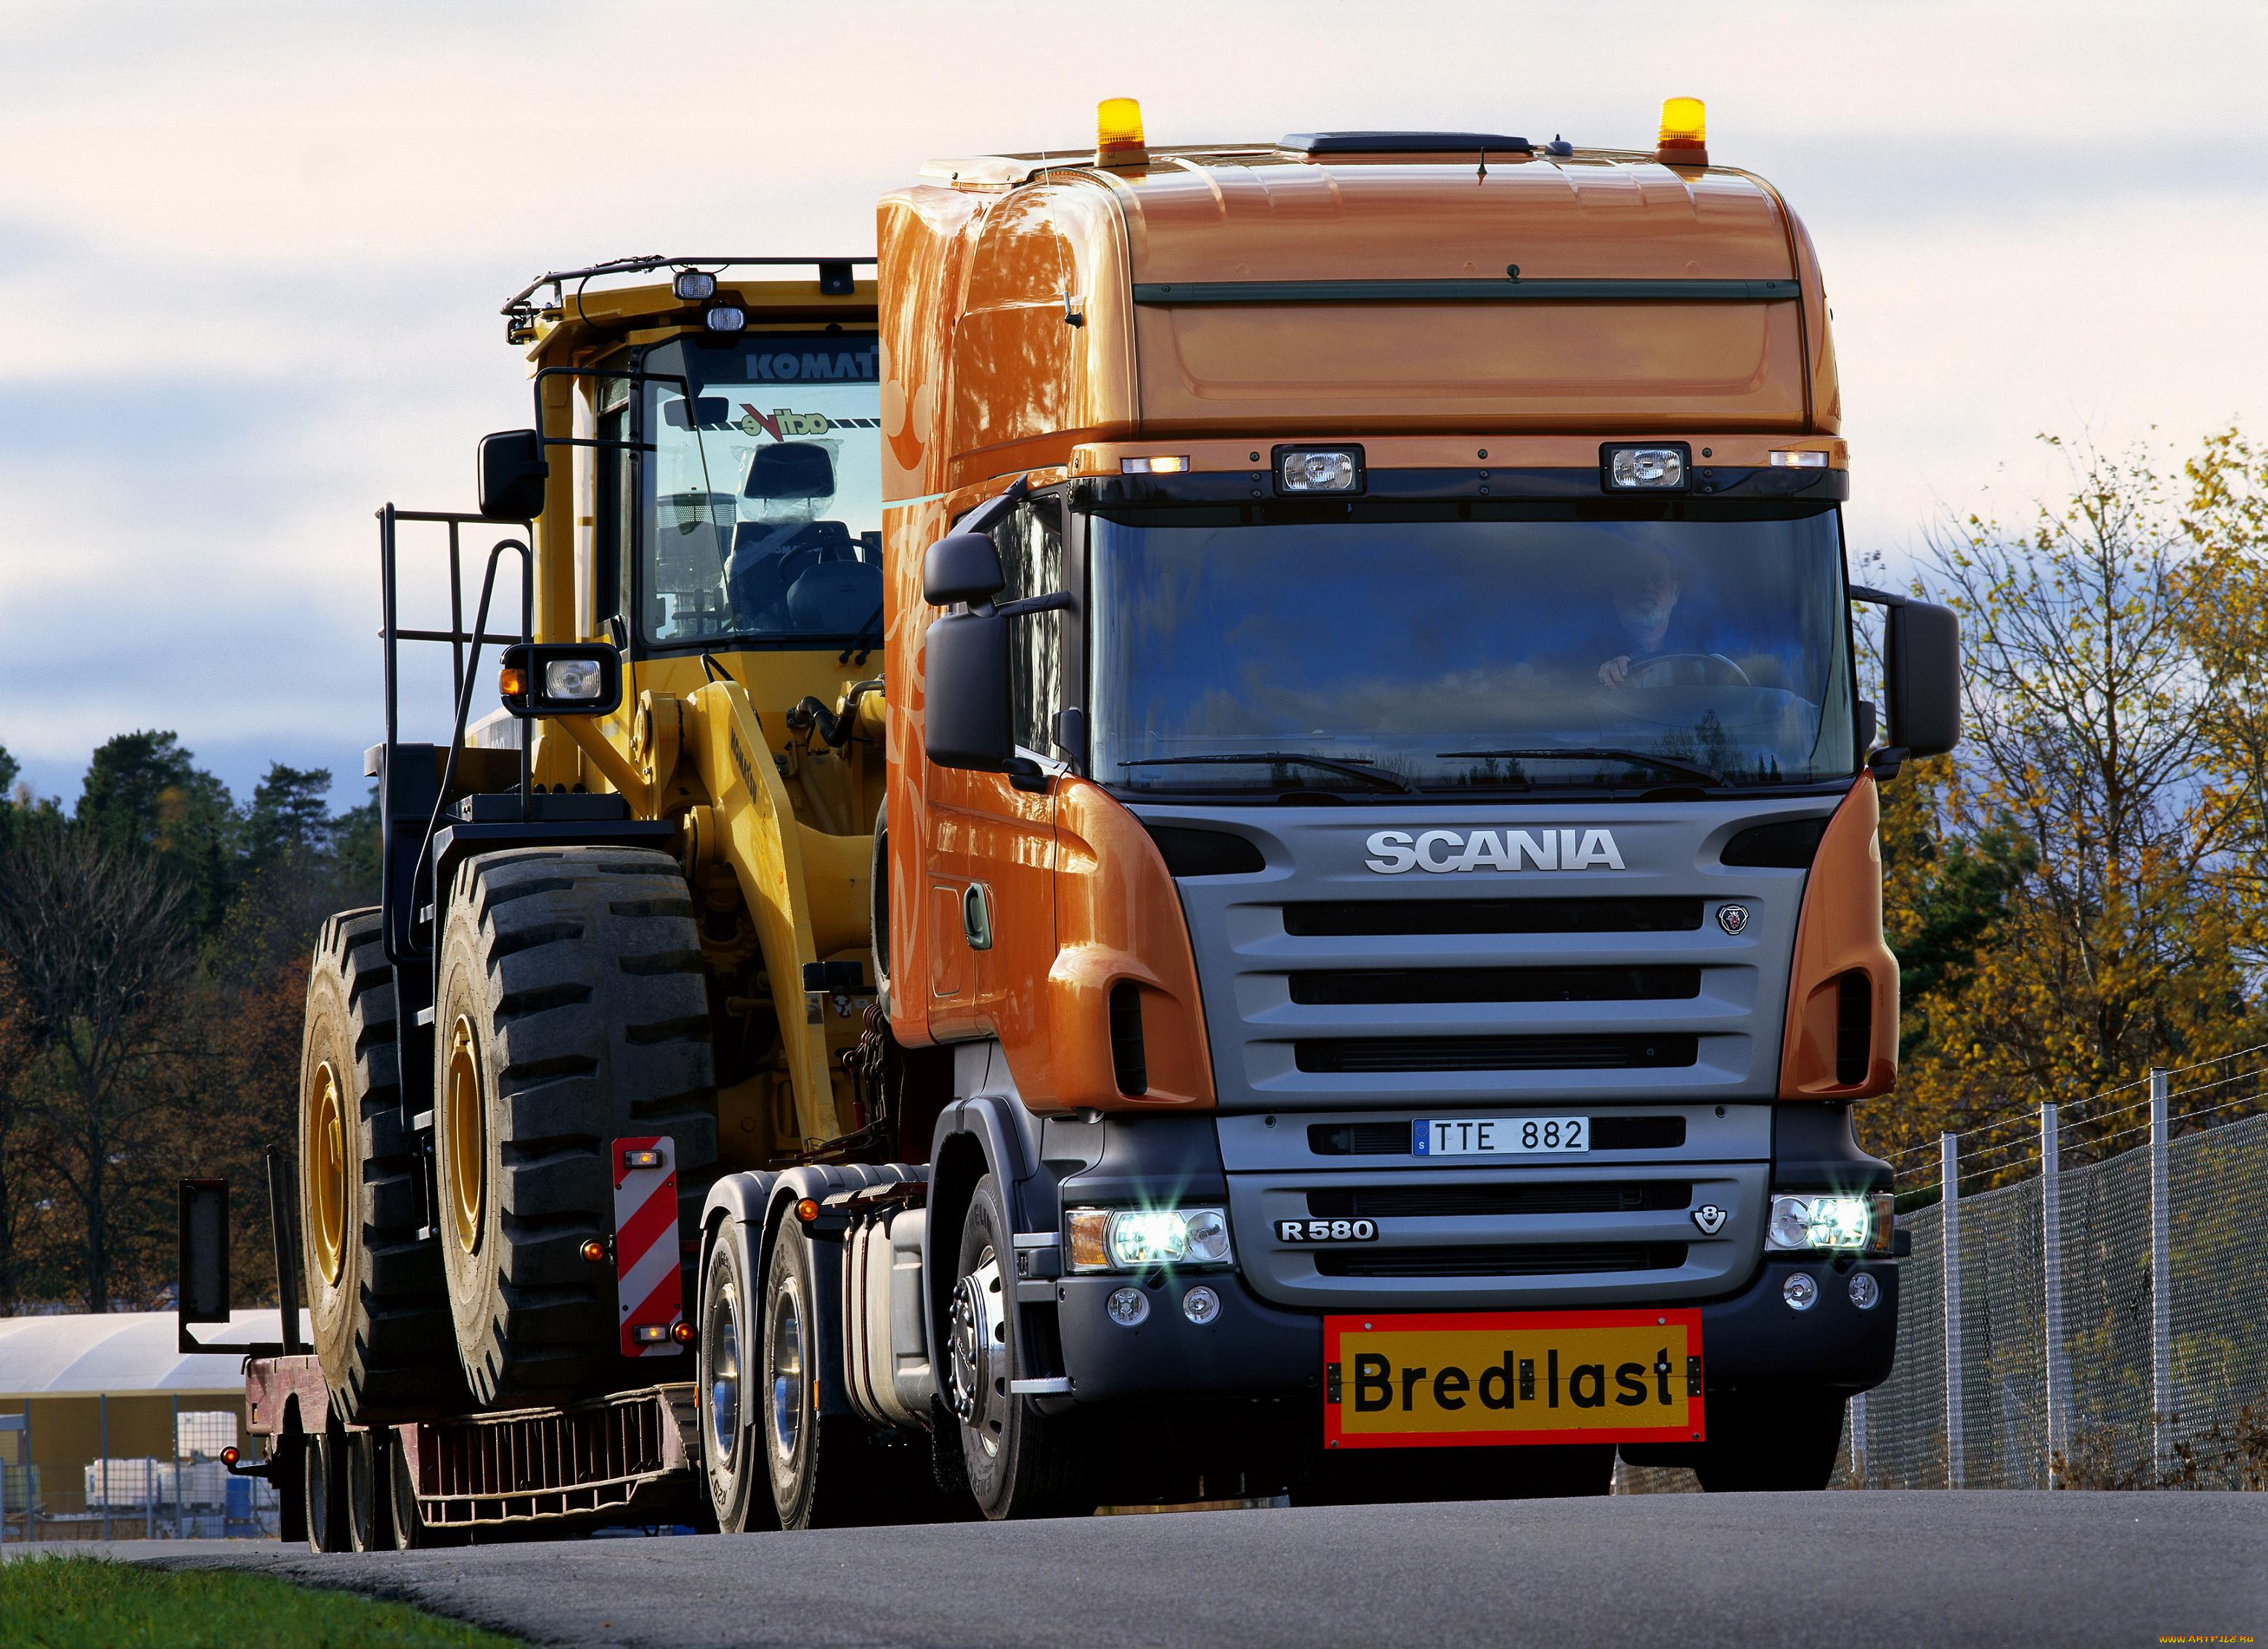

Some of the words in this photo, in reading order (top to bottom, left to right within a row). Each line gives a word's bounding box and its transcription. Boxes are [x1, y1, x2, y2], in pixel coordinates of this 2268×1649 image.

[731, 726, 757, 805] KOMATSU
[1365, 830, 1626, 874] SCANIA
[1435, 1122, 1495, 1151] TTE
[1521, 1120, 1582, 1148] 882
[1355, 1350, 1514, 1412] Bred
[1548, 1347, 1672, 1408] last
